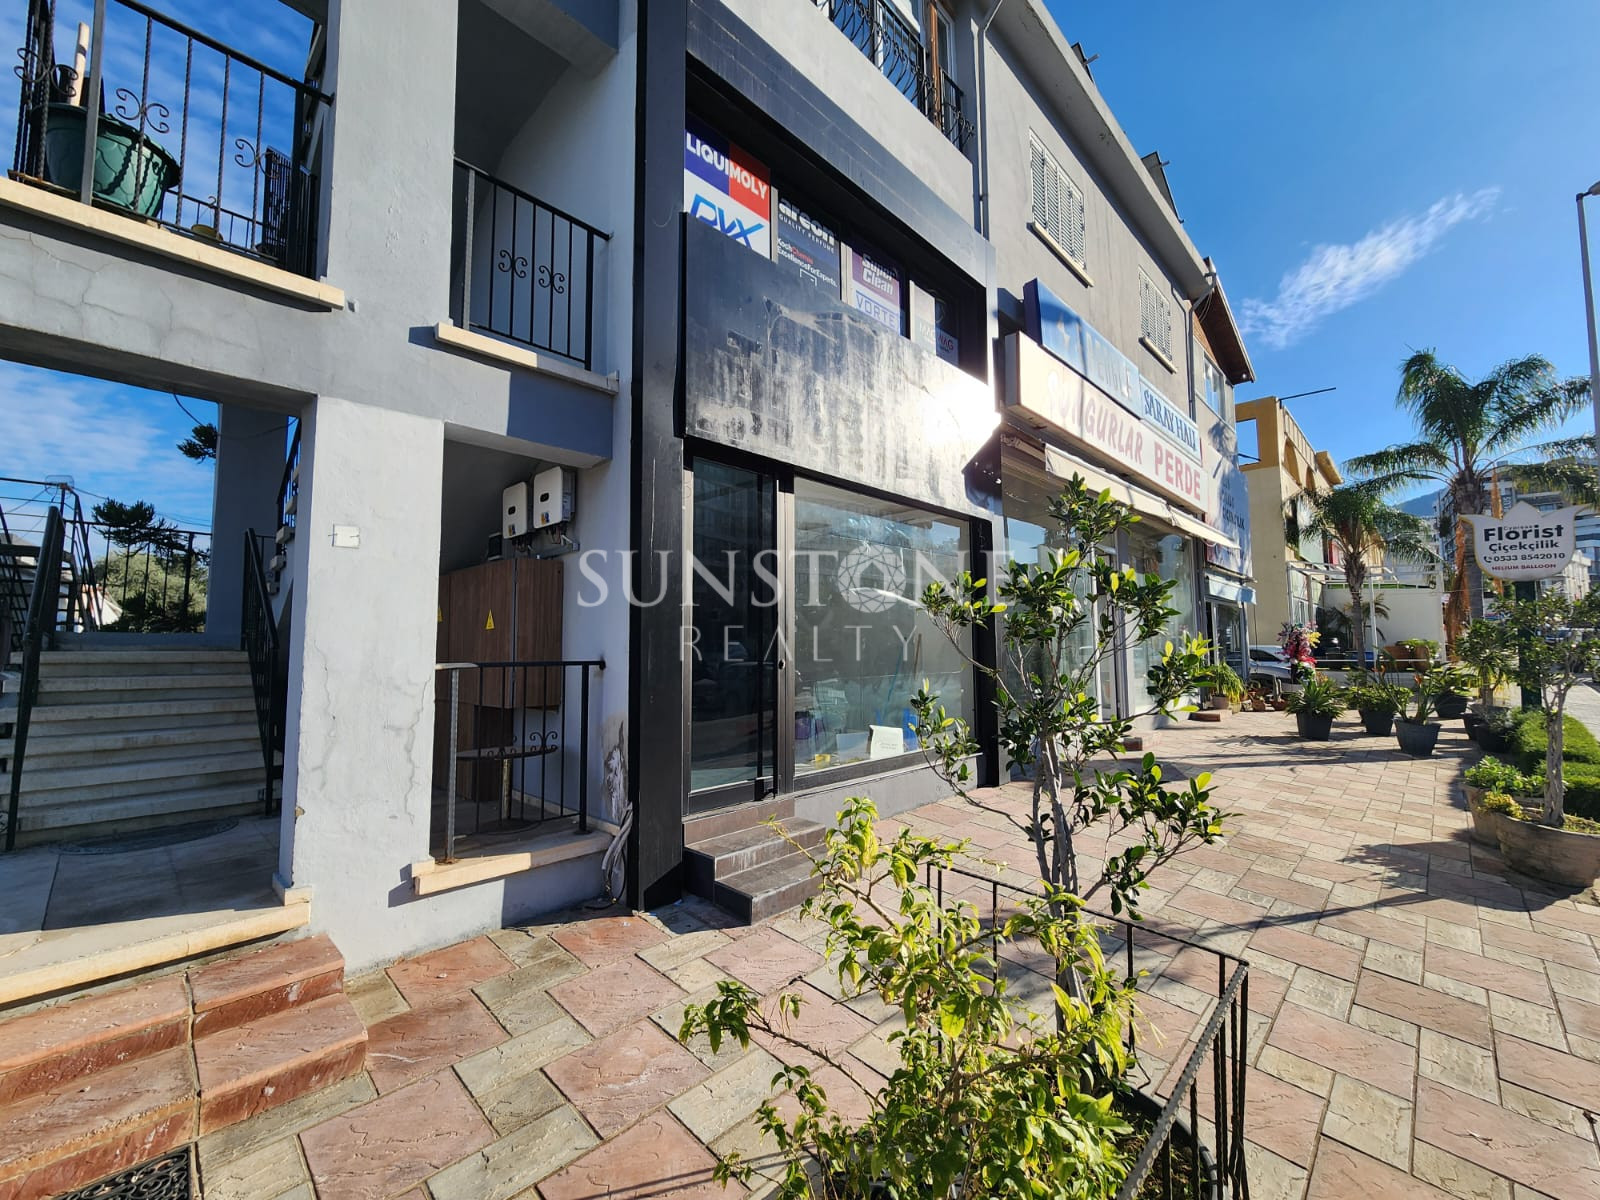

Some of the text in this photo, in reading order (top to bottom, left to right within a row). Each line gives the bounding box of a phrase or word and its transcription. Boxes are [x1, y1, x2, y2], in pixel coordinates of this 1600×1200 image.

[779, 213, 806, 236] QUALITY
[863, 267, 894, 296] Clean
[1143, 389, 1175, 434] SARAY
[1154, 441, 1201, 501] PERDE
[1484, 525, 1563, 541] Florist
[1489, 540, 1559, 553] Çiçekçilik
[1521, 552, 1566, 561] 8542010
